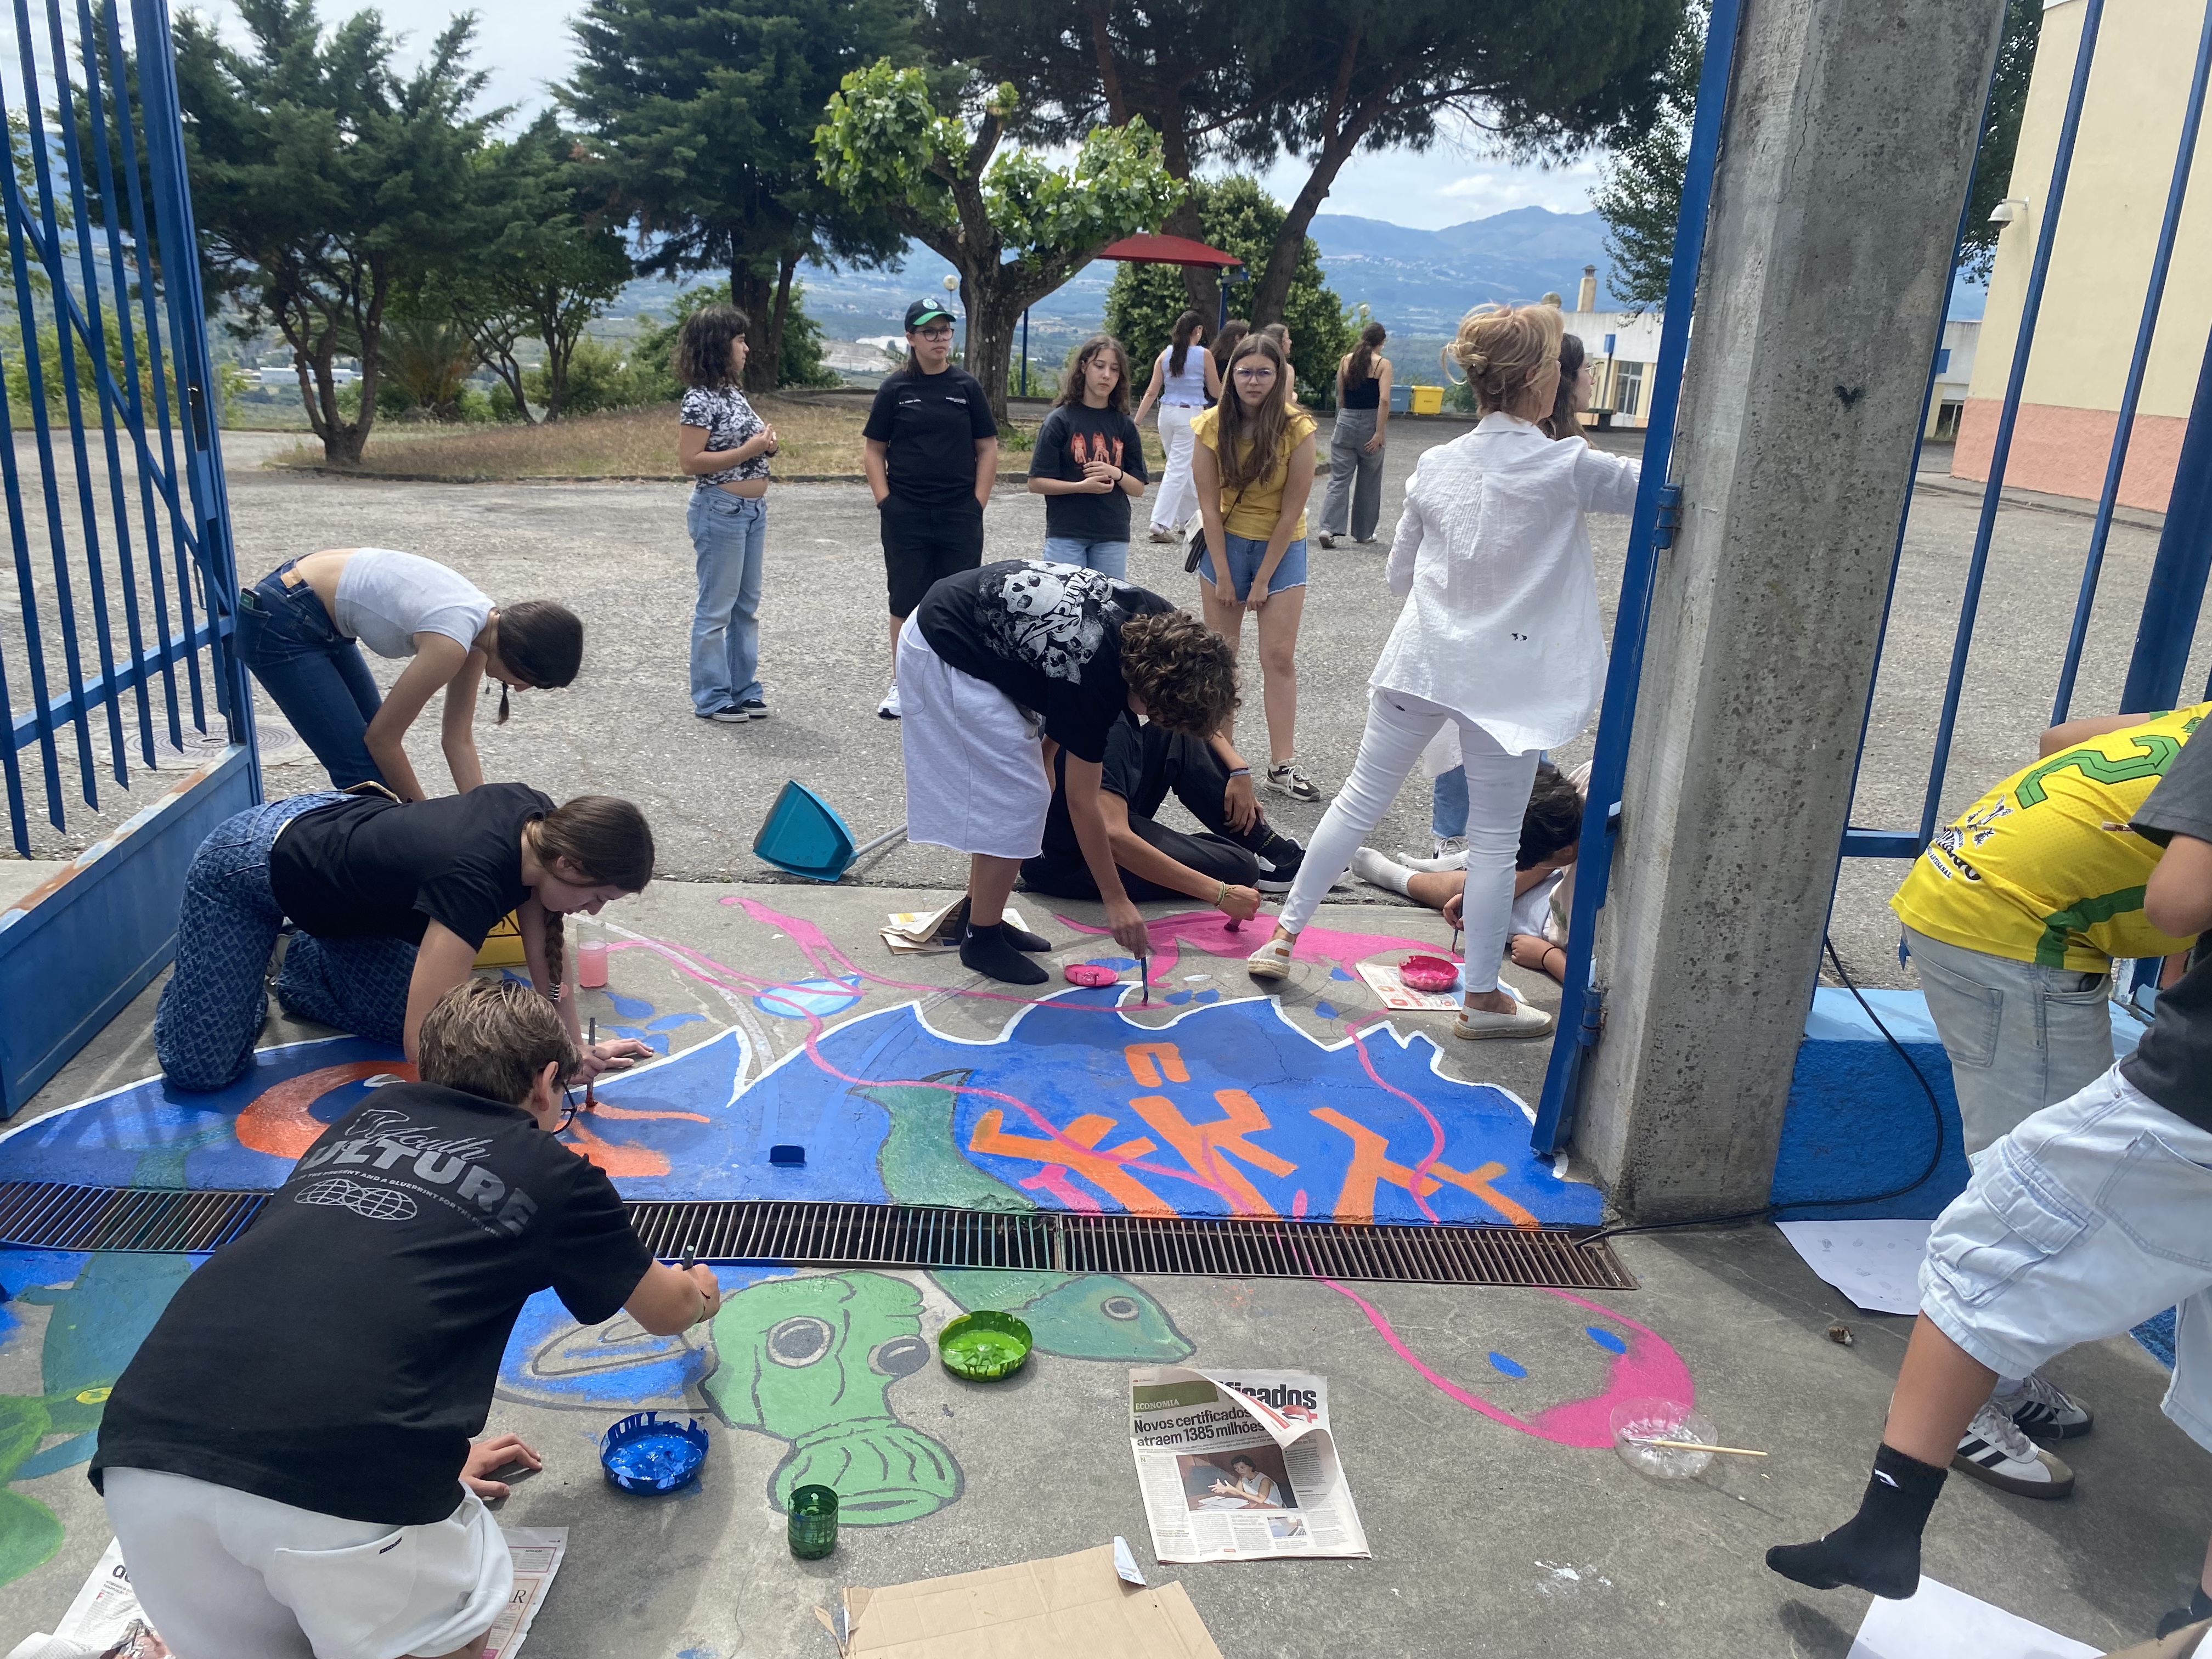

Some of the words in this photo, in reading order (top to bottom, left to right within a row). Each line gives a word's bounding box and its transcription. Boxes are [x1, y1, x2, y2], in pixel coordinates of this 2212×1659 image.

[299, 1139, 538, 1238] ULTURE
[359, 1172, 380, 1181] AND
[389, 1179, 439, 1199] BLUEPRINT
[438, 1197, 456, 1209] FOR
[1135, 1399, 1180, 1410] ECONOMIA
[1134, 1418, 1174, 1434] Novos
[1176, 1407, 1252, 1427] certificados
[1137, 1431, 1183, 1447] atraem
[1183, 1425, 1215, 1442] 1385
[1216, 1420, 1266, 1437] milhões
